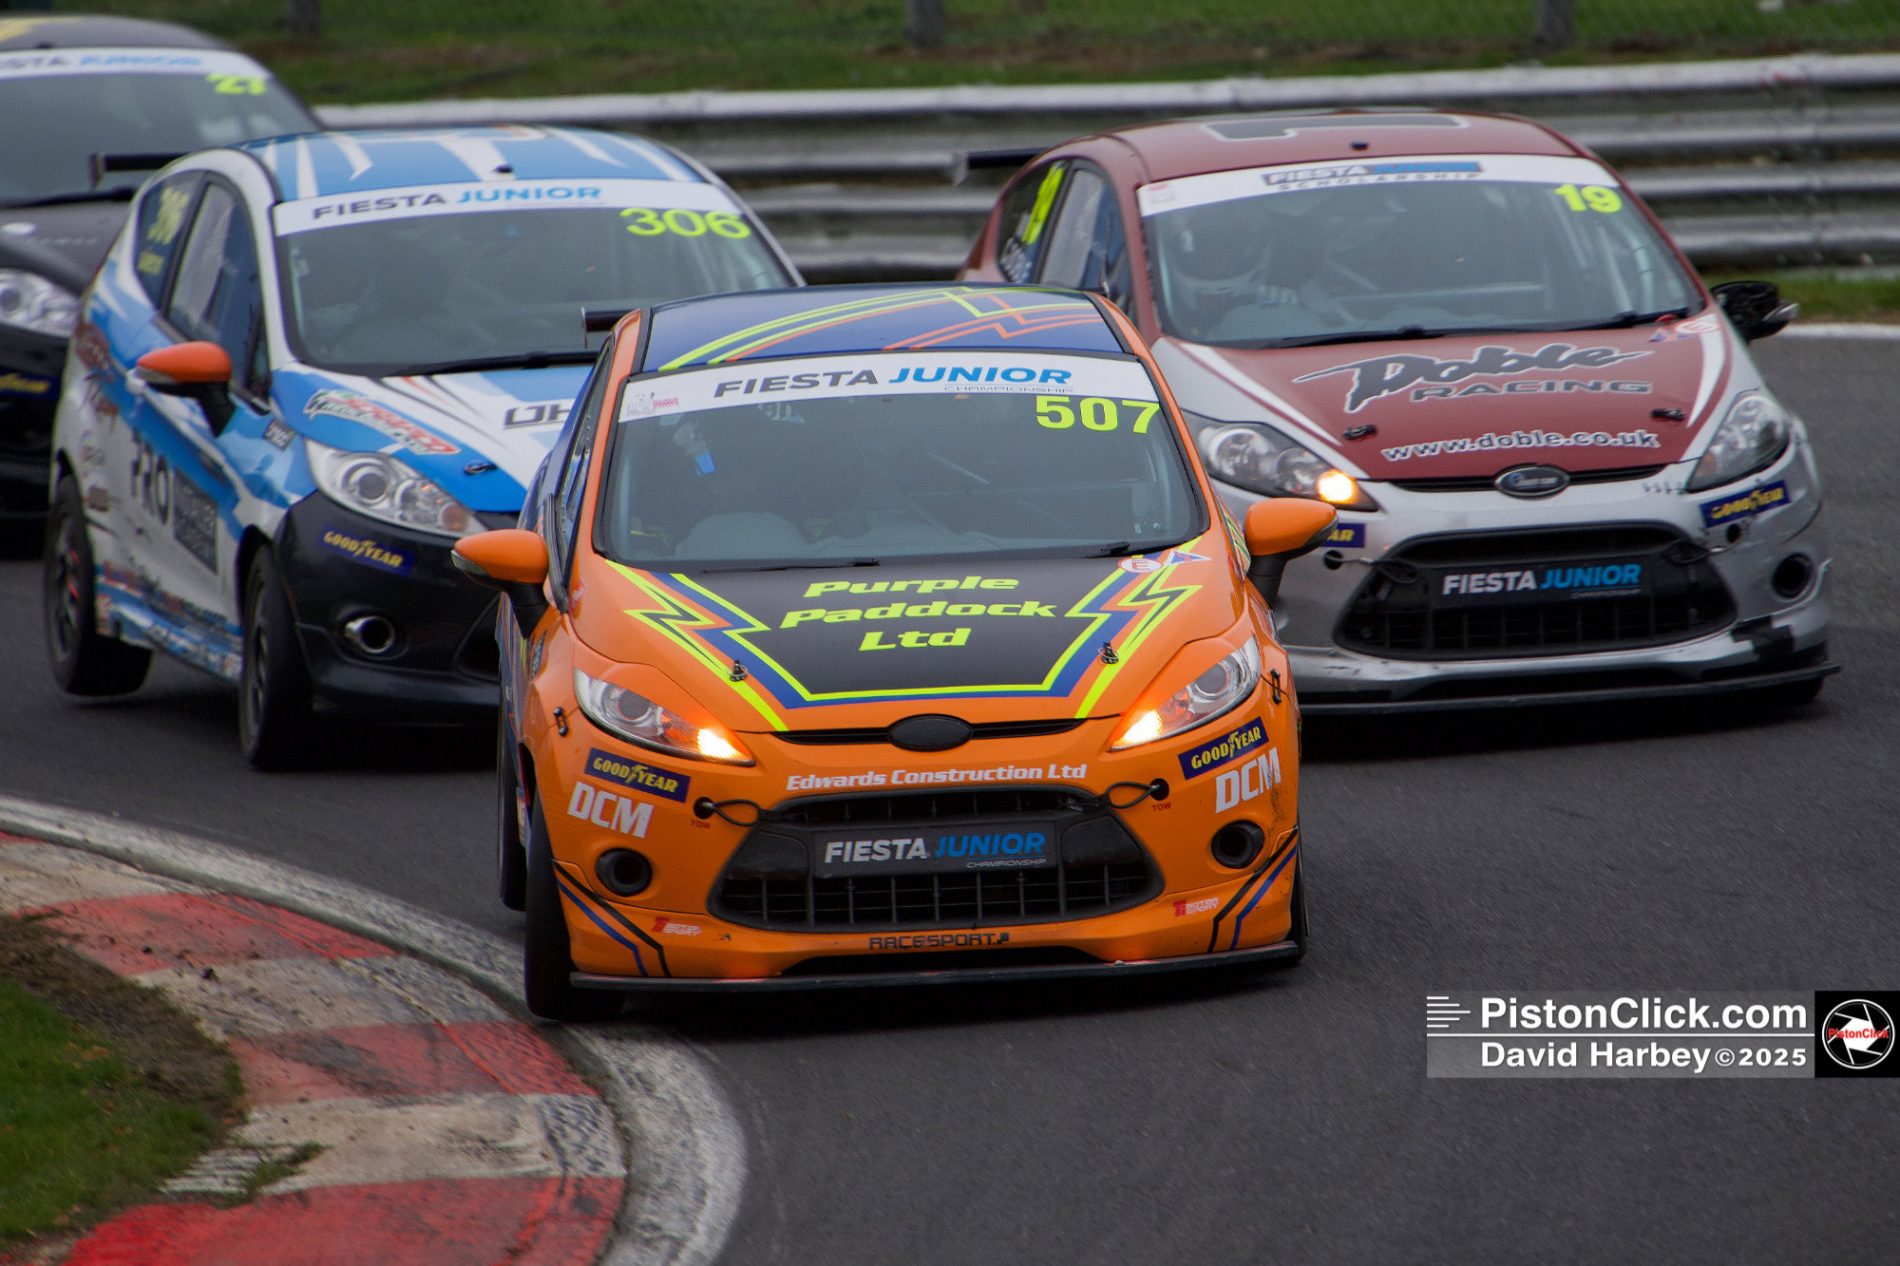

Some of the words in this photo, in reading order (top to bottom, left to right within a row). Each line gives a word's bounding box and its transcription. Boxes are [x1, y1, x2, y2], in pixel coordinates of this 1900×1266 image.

[1267, 166, 1368, 184] FIESTA
[312, 193, 446, 220] FIESTA
[458, 186, 603, 204] JUNIOR
[1553, 184, 1623, 213] 19
[619, 207, 751, 239] 306
[713, 369, 879, 398] FIESTA
[888, 367, 1072, 385] JUNIOR
[1292, 344, 1654, 413] Doble
[1410, 379, 1653, 402] RACING
[1035, 395, 1160, 434] 507
[1382, 430, 1662, 462] www.doble.co.uk
[323, 530, 404, 568] GOODYEAR
[803, 575, 1019, 598] Purple
[1442, 570, 1537, 595] FIESTA
[1540, 563, 1642, 589] JUNIOR
[779, 601, 1057, 629] Paddock
[858, 627, 972, 652] Ltd
[1191, 726, 1262, 770] GOODYEAR
[592, 757, 678, 793] GOODYEAR
[786, 771, 887, 791] Edwards
[890, 764, 1046, 785] Construction
[1047, 763, 1088, 779] Ltd
[1215, 746, 1282, 815] DCM
[567, 781, 655, 839] DCM
[1152, 803, 1172, 812] TOW
[824, 838, 931, 863] FIESTA
[936, 832, 1046, 858] JUNIOR
[869, 932, 996, 950] RACESPORT
